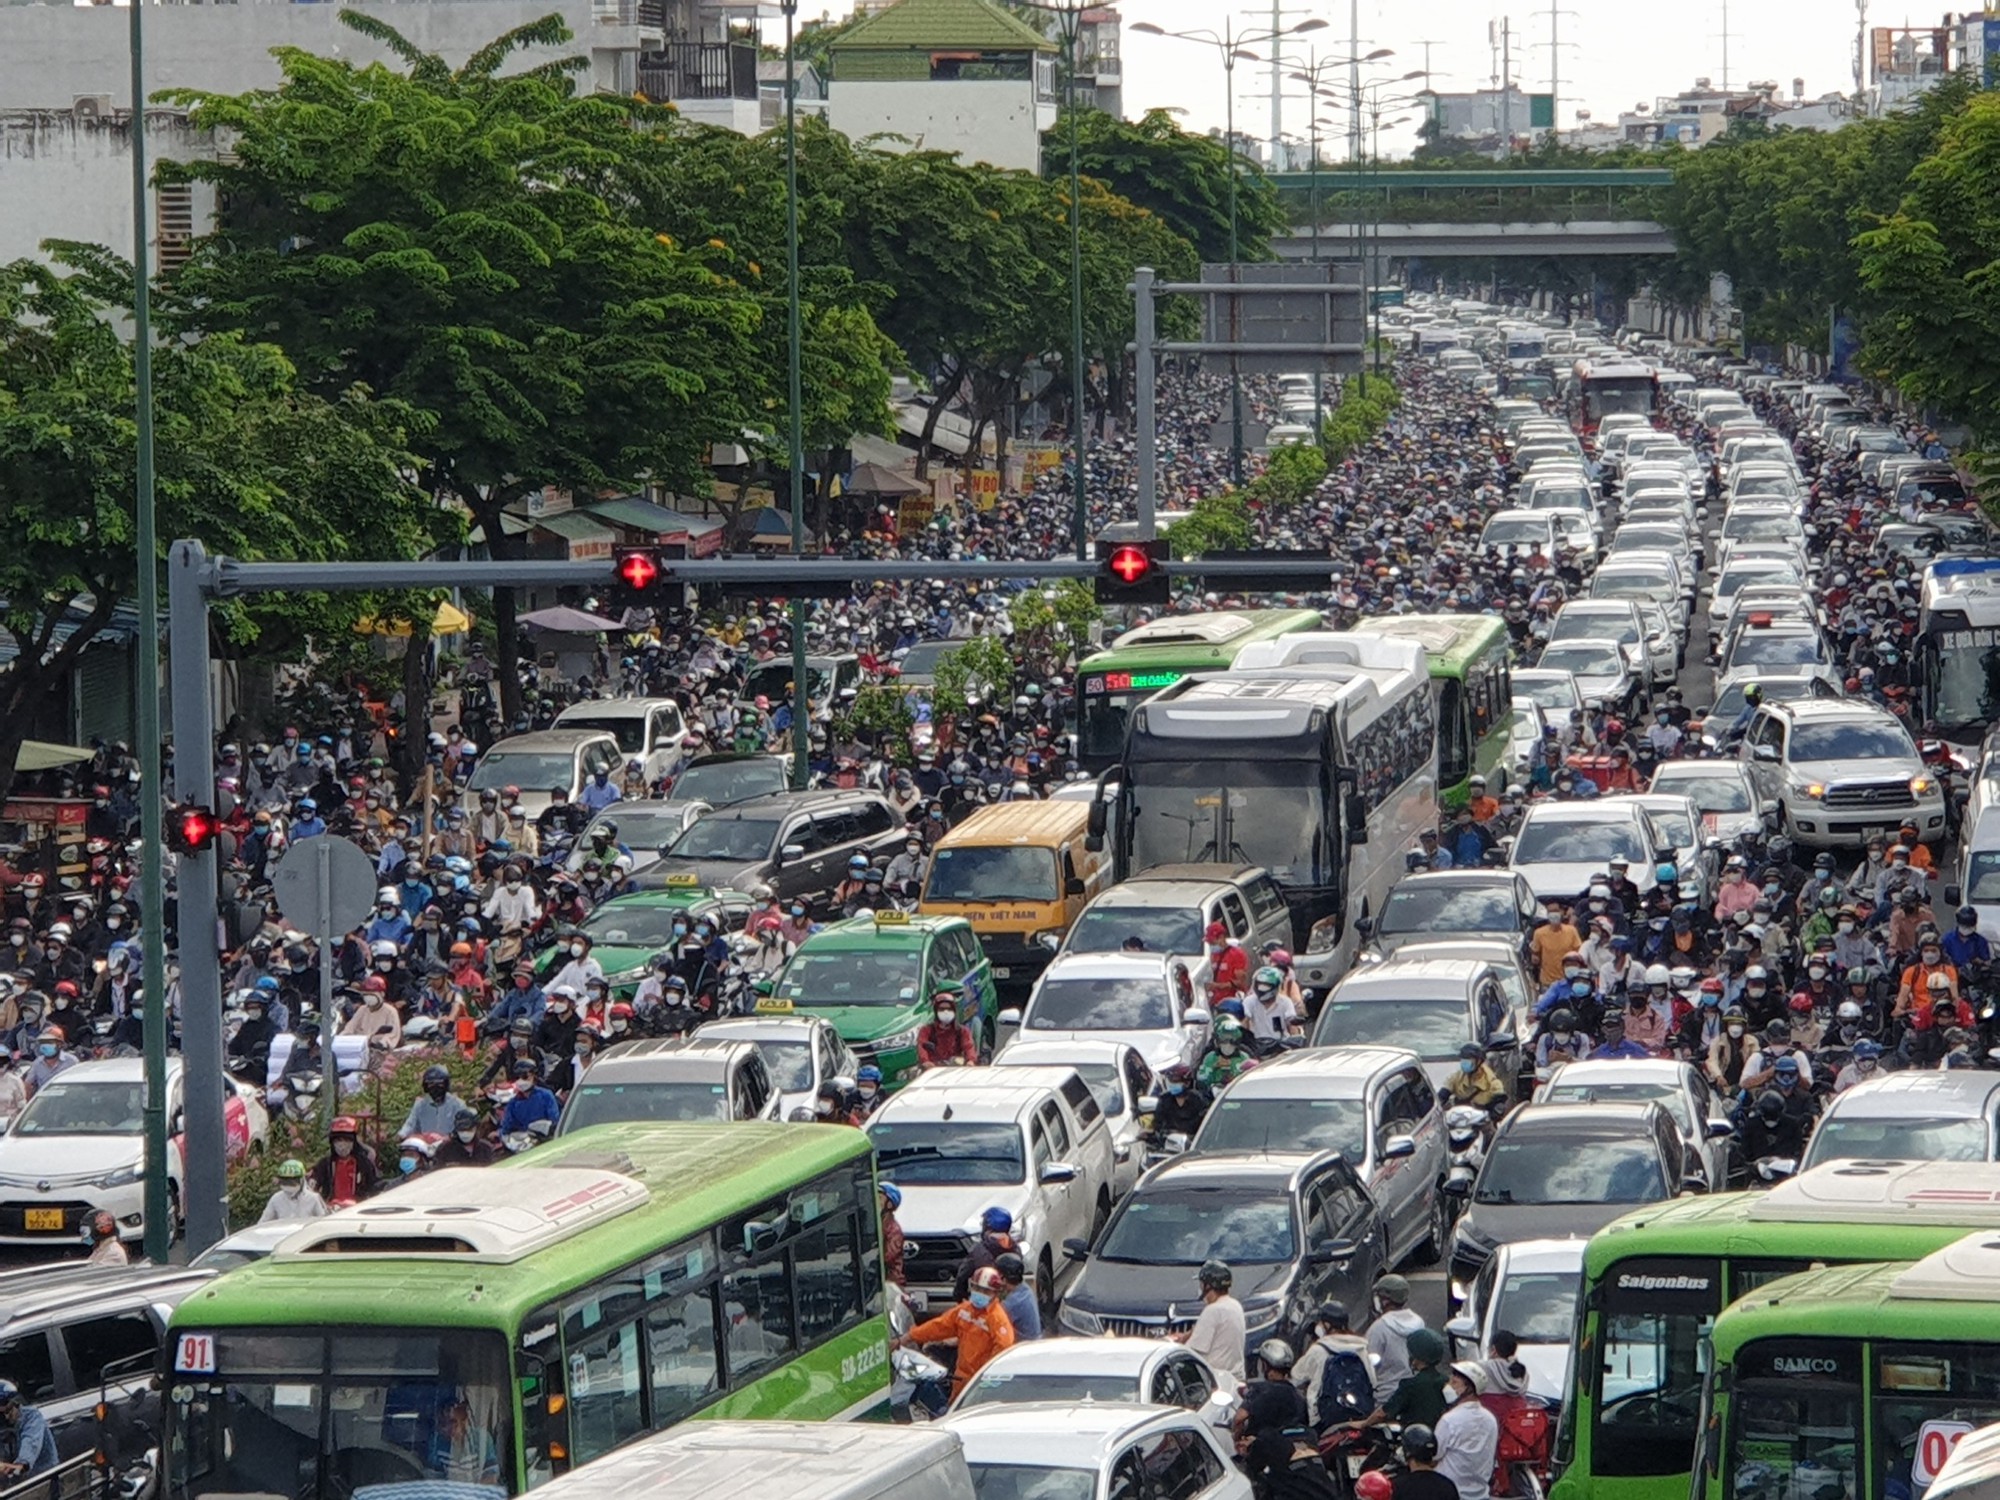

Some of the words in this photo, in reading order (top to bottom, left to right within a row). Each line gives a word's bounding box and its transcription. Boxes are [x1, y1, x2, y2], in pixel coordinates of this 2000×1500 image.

[1088, 681, 1100, 692] 50
[1013, 910, 1036, 919] NAM
[1617, 1274, 1710, 1290] SaigonBus
[185, 1337, 207, 1369] 91
[1773, 1357, 1838, 1373] SAMCO
